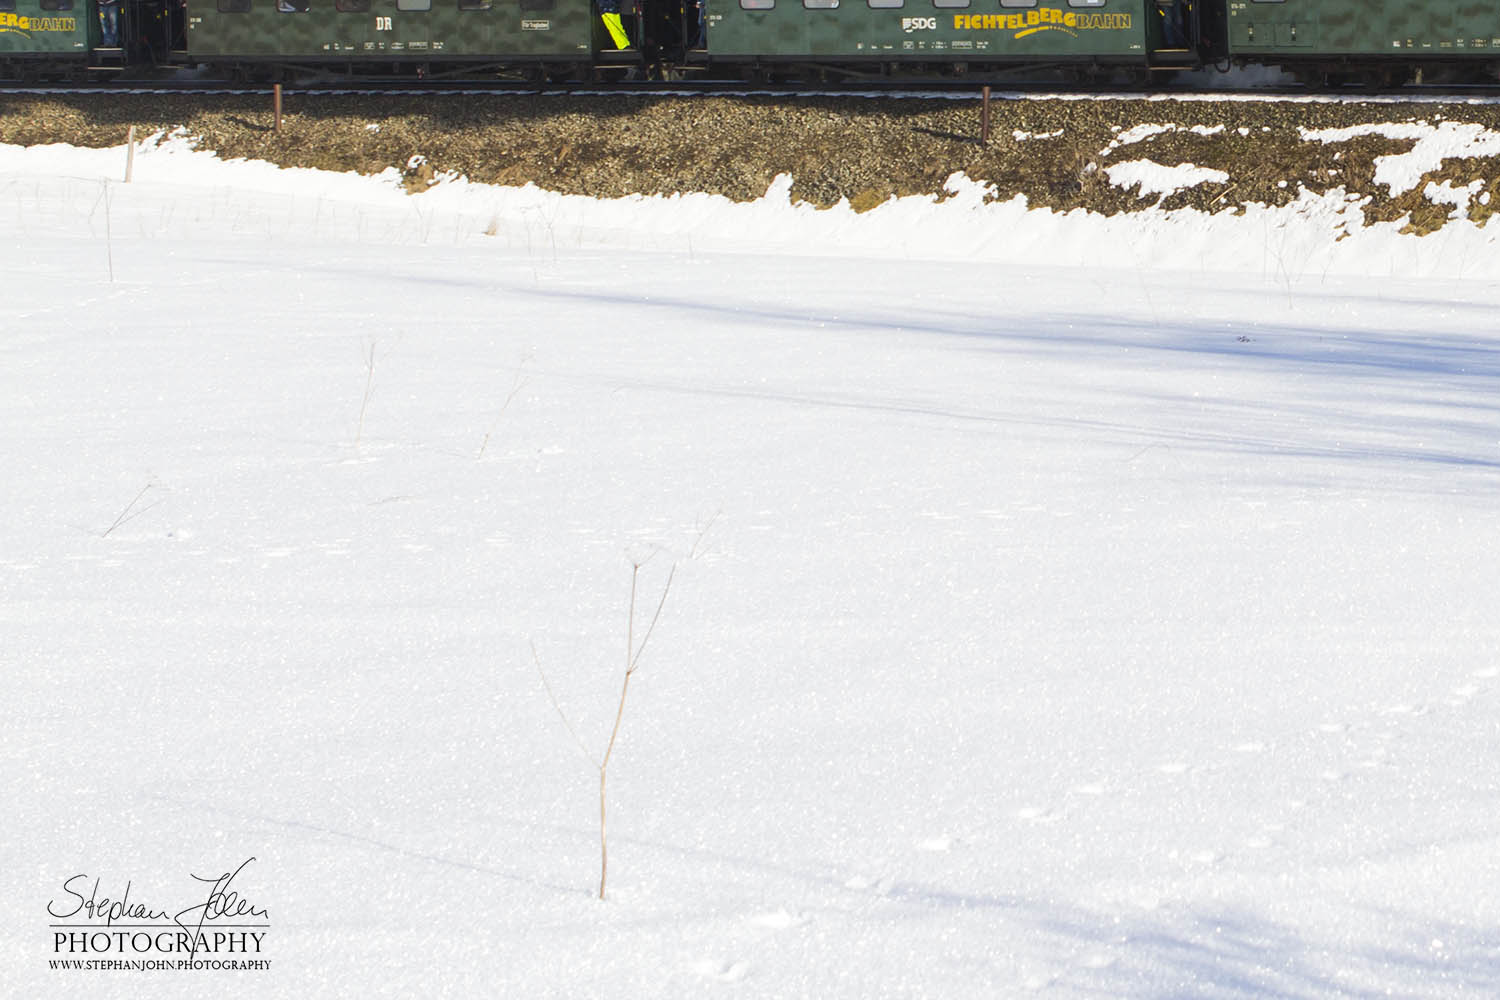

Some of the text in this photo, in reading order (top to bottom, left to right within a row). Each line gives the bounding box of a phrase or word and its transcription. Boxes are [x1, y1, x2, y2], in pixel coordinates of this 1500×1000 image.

[375, 16, 393, 31] DR
[911, 17, 936, 30] SDG
[953, 8, 1131, 30] FICHTELBERGBAHN
